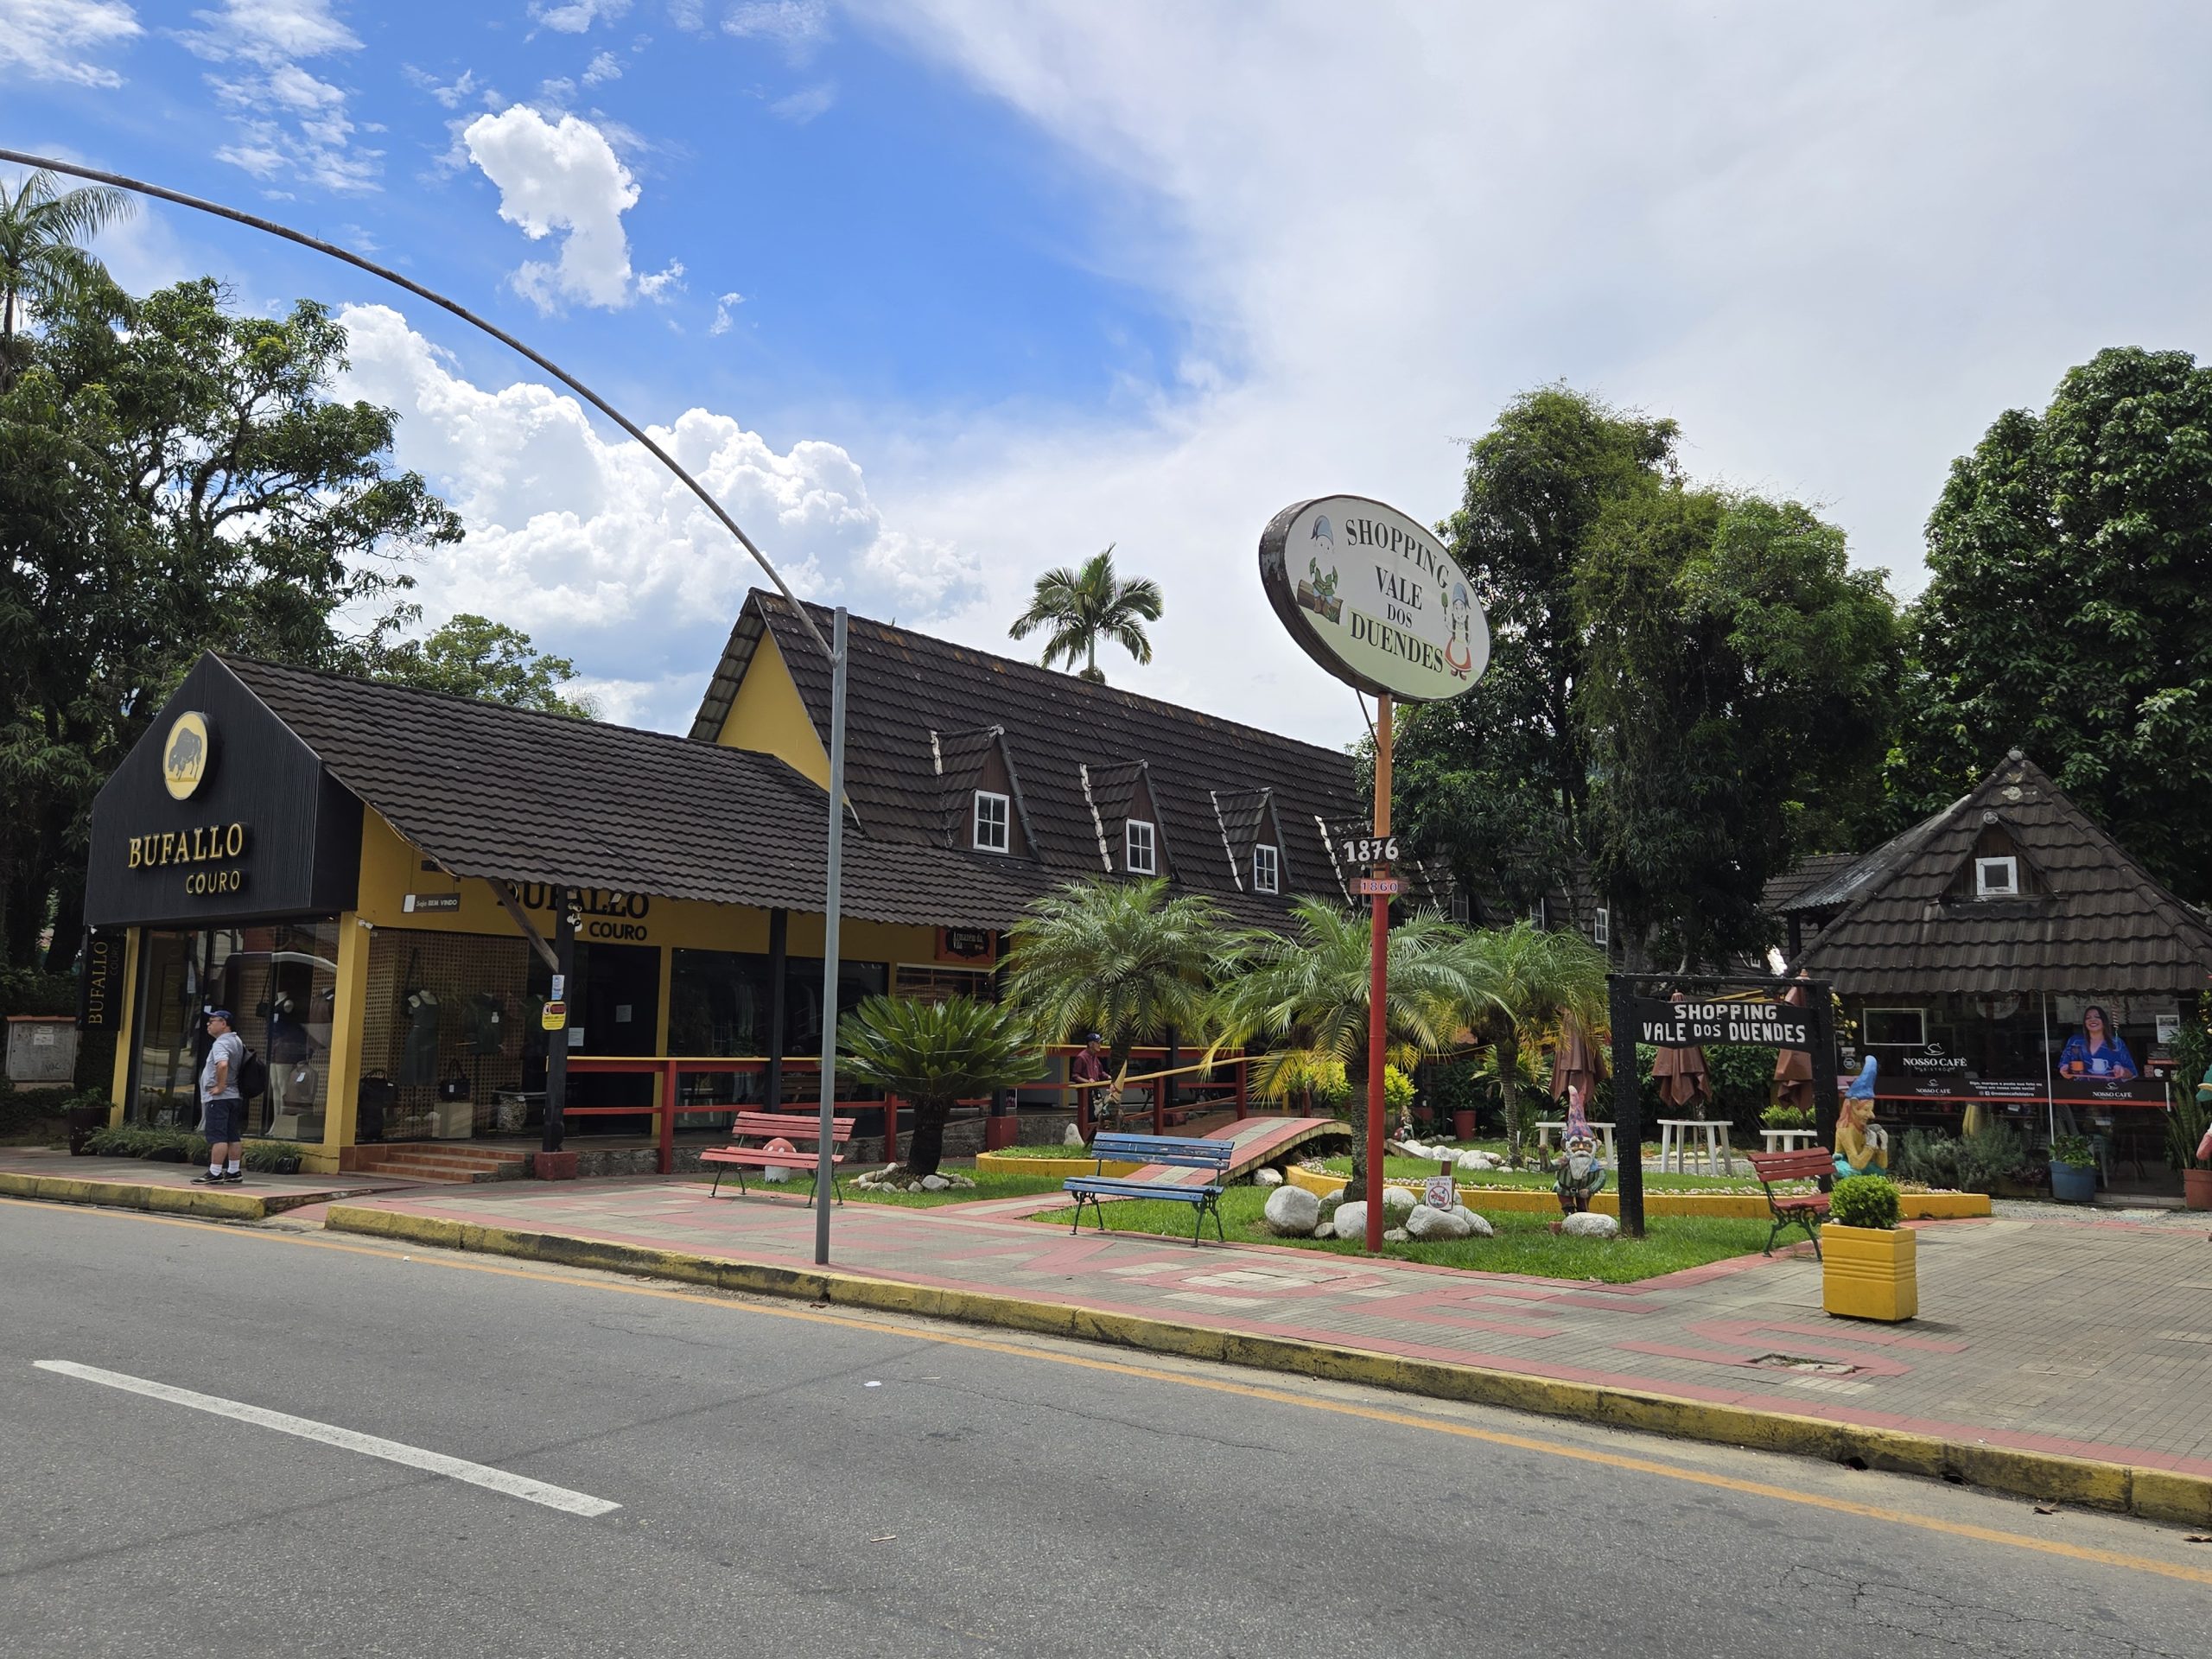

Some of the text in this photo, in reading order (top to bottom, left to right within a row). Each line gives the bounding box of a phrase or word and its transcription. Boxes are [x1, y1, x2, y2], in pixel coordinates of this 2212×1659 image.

[1345, 518, 1449, 589] SHOPPING
[1375, 565, 1422, 610] VALE
[1387, 603, 1413, 628] DOS
[1350, 611, 1443, 673] DUENDES
[128, 822, 244, 869] BUFALLO
[1343, 837, 1399, 862] 1876
[185, 870, 241, 894] COURO
[1360, 881, 1398, 892] 1860
[588, 921, 648, 941] COURO
[88, 941, 109, 1025] BUFALLO
[1674, 1004, 1778, 1020] SHOPPING
[1643, 1022, 1806, 1043] VALE DOS DUENDES
[1903, 1058, 1938, 1067] NOSSO
